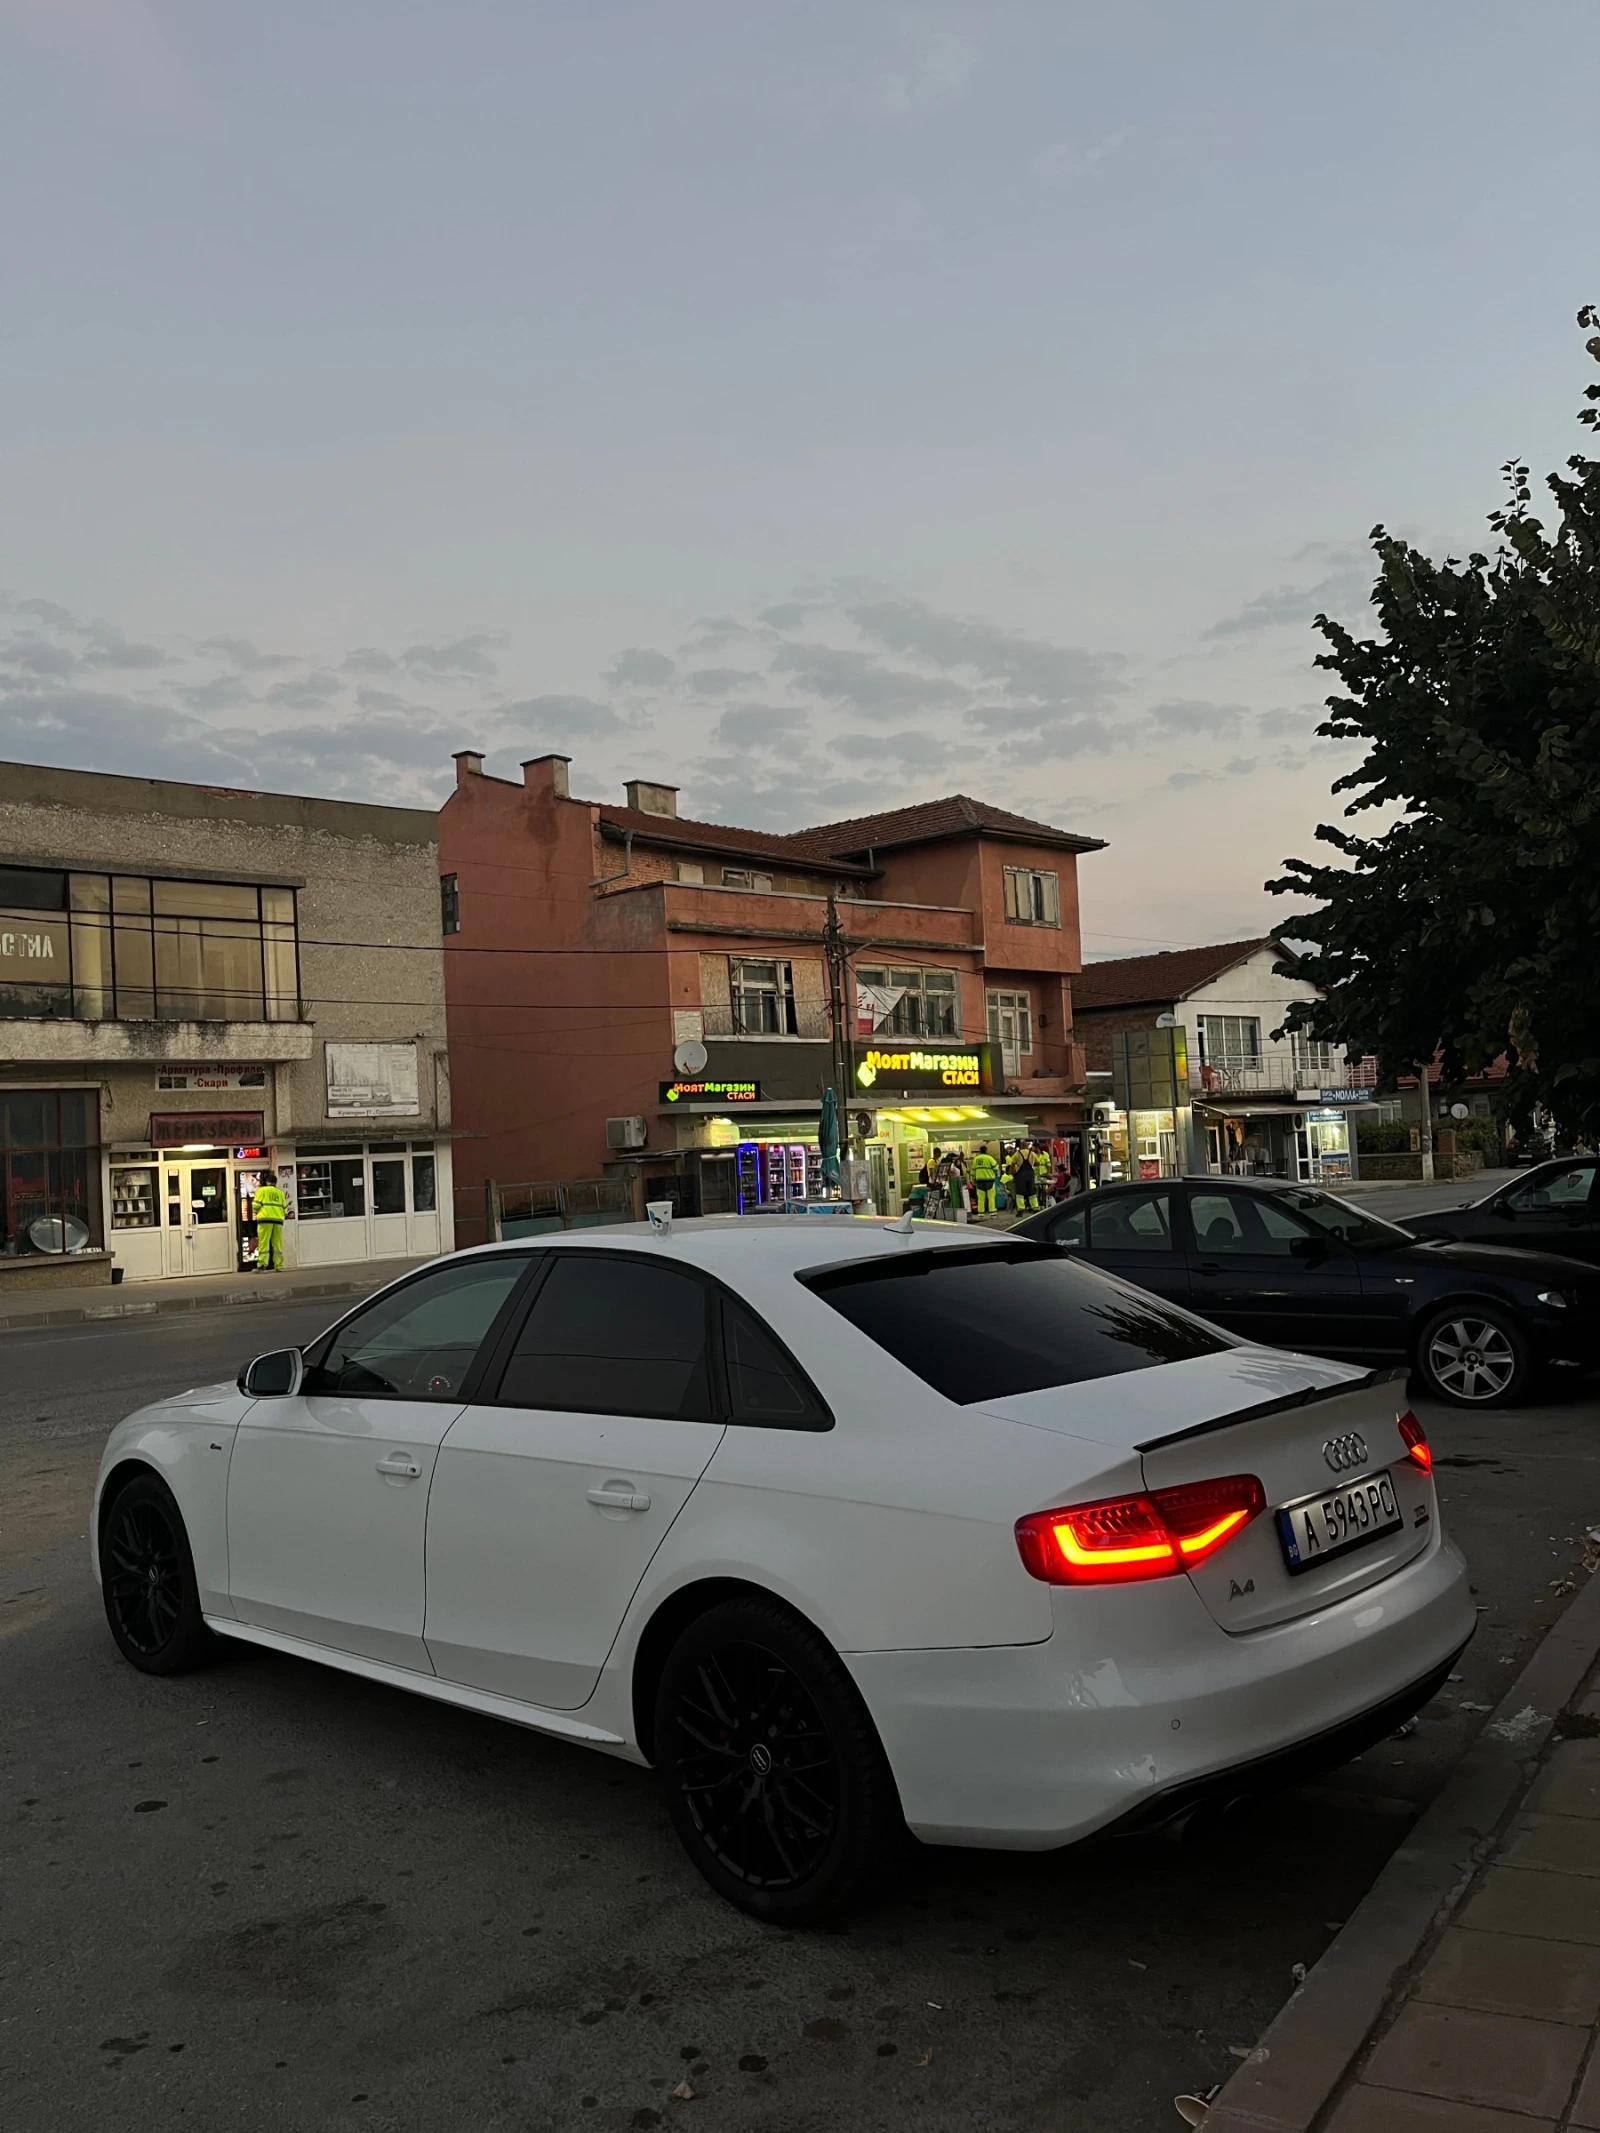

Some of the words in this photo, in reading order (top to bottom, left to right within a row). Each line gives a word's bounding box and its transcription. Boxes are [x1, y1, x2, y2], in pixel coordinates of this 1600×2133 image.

[0, 933, 53, 958] СТИЛ
[160, 1065, 211, 1076] Арматура
[197, 1078, 229, 1089] Скари
[942, 1071, 979, 1085] СТАСИ
[727, 1092, 755, 1100] СТАСИ
[1289, 1544, 1299, 1558] BG
[1228, 1579, 1256, 1602] A4
